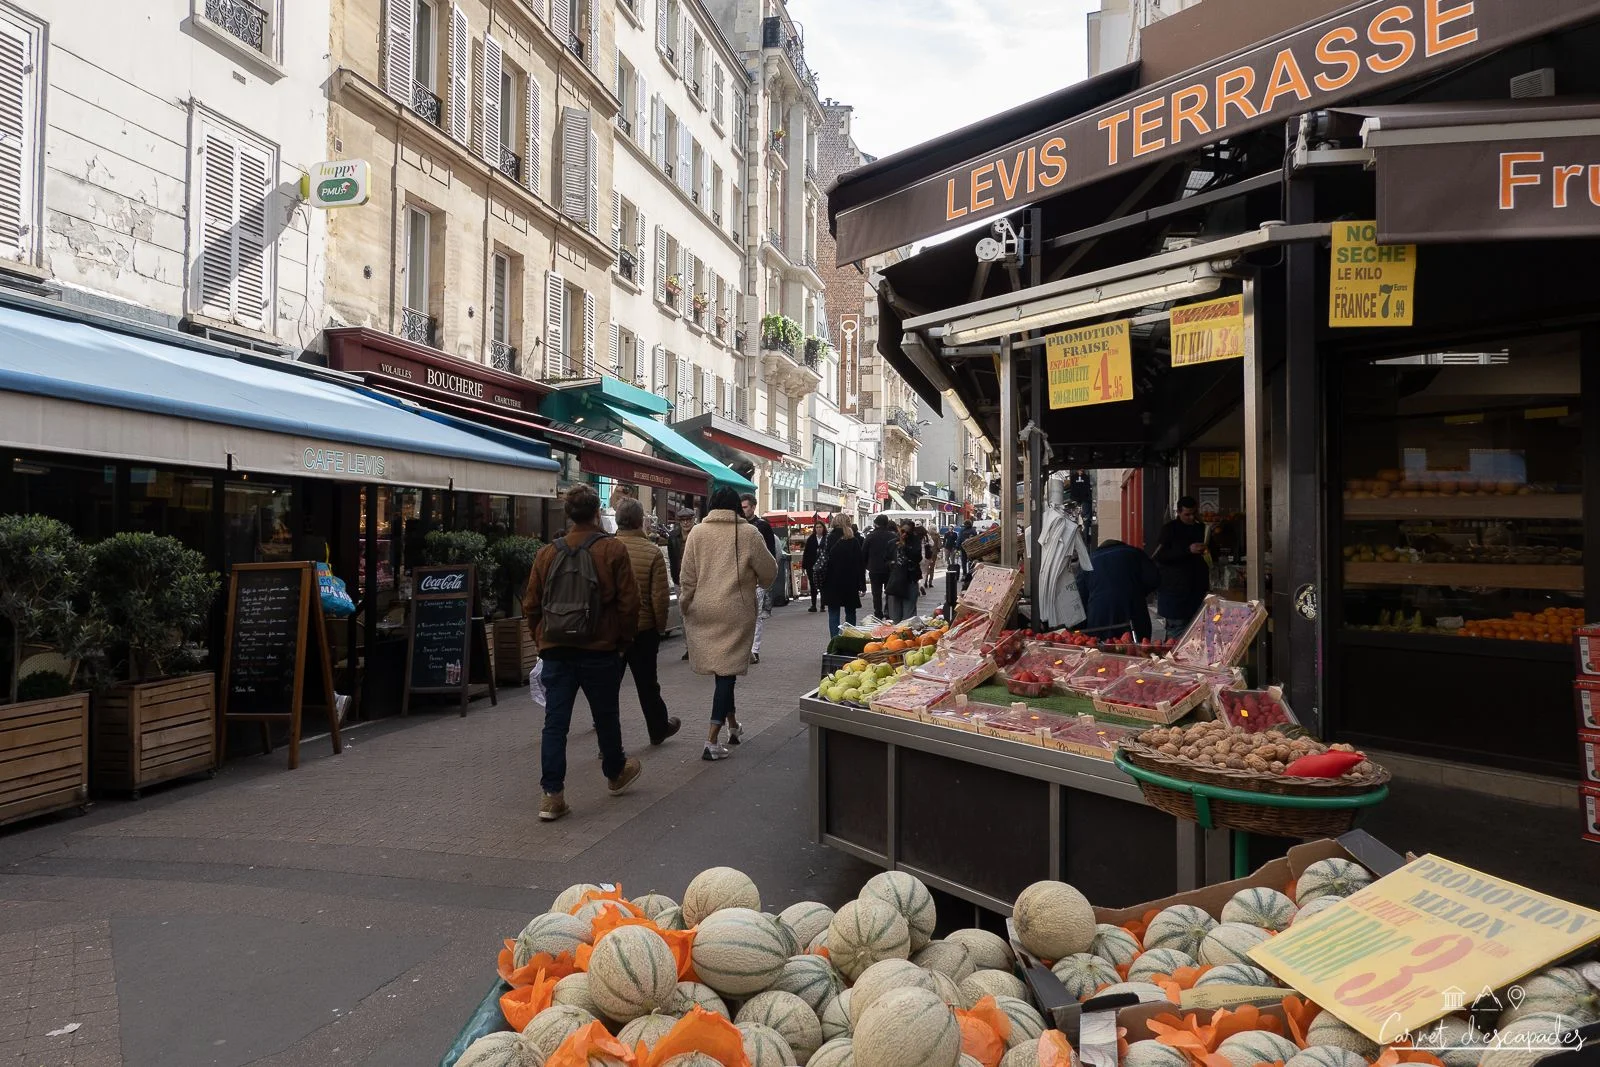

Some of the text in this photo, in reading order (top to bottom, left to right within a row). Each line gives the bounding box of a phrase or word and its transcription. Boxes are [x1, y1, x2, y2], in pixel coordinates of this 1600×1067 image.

[946, 0, 1479, 221] LEVIS TERRASSE
[320, 164, 357, 177] happy
[322, 187, 341, 196] PMU
[1337, 246, 1406, 263] SECHE
[1338, 267, 1382, 280] LE KILO
[1334, 293, 1376, 318] FRANCE
[1048, 324, 1124, 347] PROMOTION
[1063, 341, 1110, 357] FRAISE
[381, 363, 412, 379] VOLAILLES
[427, 368, 484, 399] BOUCHERIE
[494, 395, 522, 409] CHARCUTERIE
[303, 447, 385, 476] CAFE LEVIS
[1407, 857, 1599, 935] PROMOTION
[1402, 888, 1516, 939] MELON
